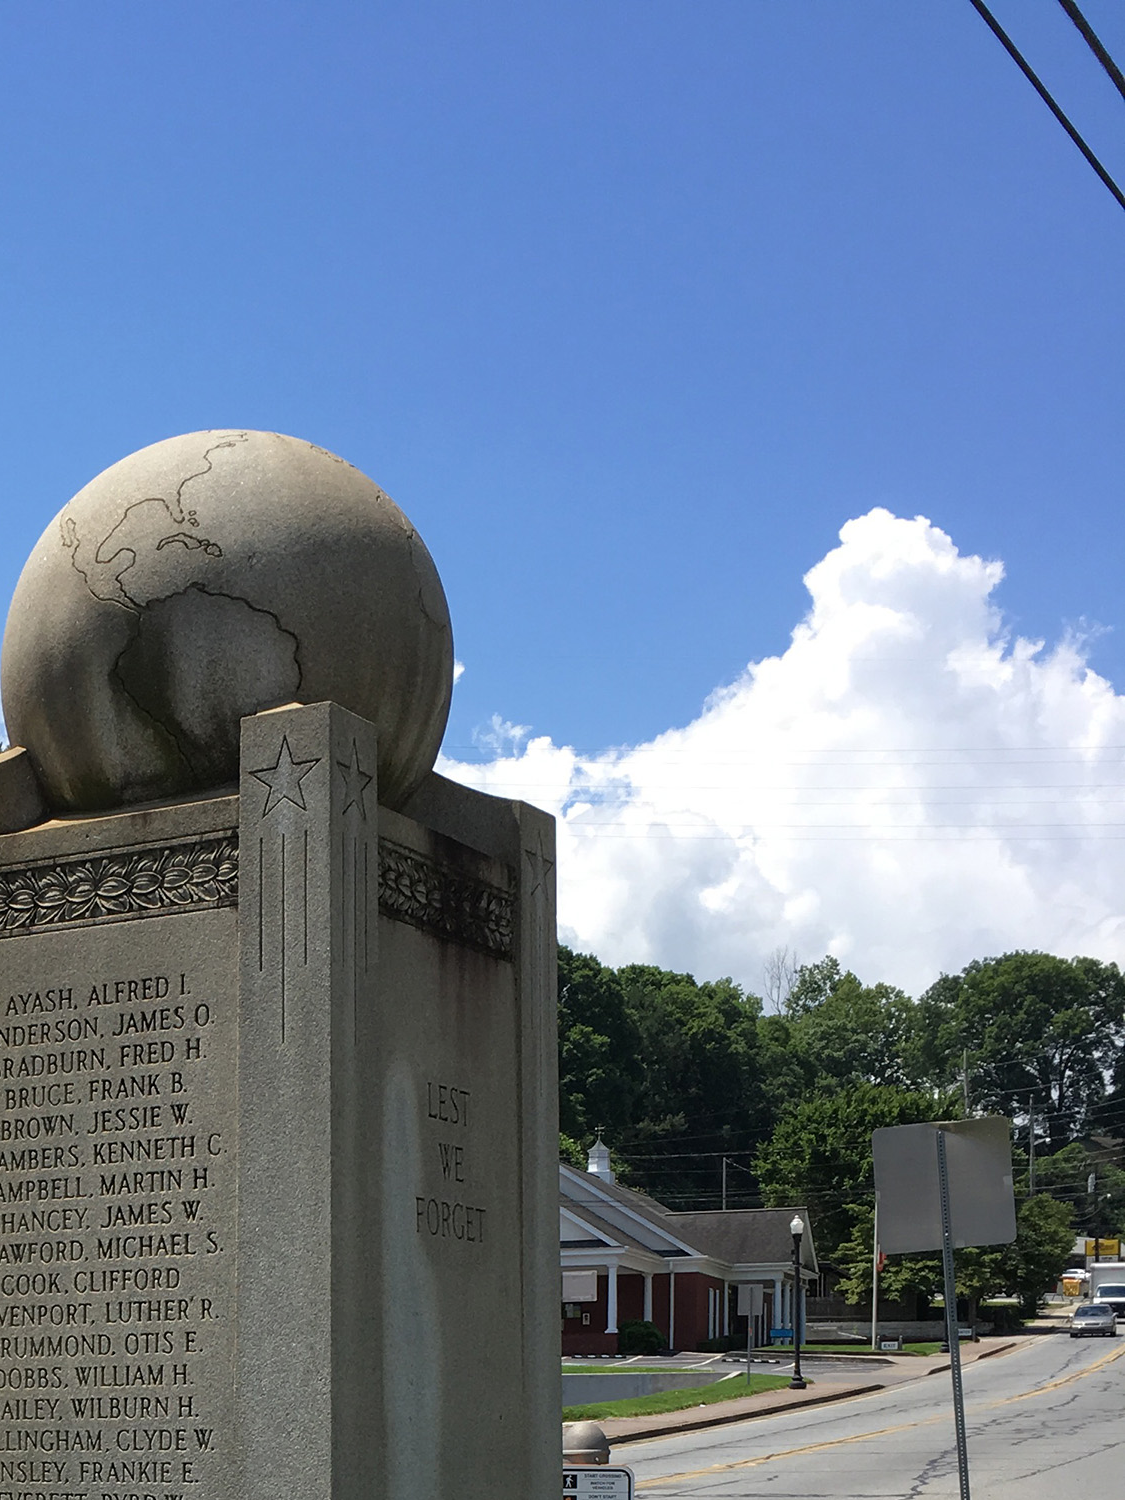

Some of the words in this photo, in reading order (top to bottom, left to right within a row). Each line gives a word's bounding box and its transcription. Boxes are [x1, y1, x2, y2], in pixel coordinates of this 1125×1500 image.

[5, 987, 78, 1016] AYASH,
[88, 976, 170, 1007] ALFRED
[112, 1007, 185, 1036] JAMES
[194, 1003, 214, 1027] O.
[120, 1040, 175, 1068] FRED
[185, 1037, 207, 1060] H.
[5, 1081, 82, 1111] BRUCE,
[88, 1074, 161, 1102] FRANK
[170, 1072, 187, 1094] B.
[427, 1082, 470, 1127] LEST
[1, 1113, 79, 1141] BROWN,
[87, 1107, 163, 1135] JESSIE
[171, 1103, 192, 1126] W.
[93, 1136, 195, 1165] KENNETH
[208, 1133, 227, 1157] C.
[439, 1143, 464, 1183] WE
[100, 1170, 182, 1197] MARTIN
[193, 1167, 215, 1190] H.
[100, 1202, 172, 1229] JAMES
[183, 1199, 204, 1222] W.
[416, 1196, 486, 1243] FORGET
[97, 1233, 196, 1262] MICHAEL
[206, 1231, 223, 1255] S.
[1, 1273, 68, 1296] COOK,
[74, 1268, 180, 1293] CLIFFORD
[106, 1300, 190, 1324] LUTHER
[201, 1298, 219, 1320] R.
[125, 1332, 173, 1355] OTIS
[185, 1331, 203, 1353] E.
[75, 1365, 163, 1387] WILLIAM
[173, 1363, 194, 1385] H.
[71, 1397, 169, 1419] WILBURN
[179, 1396, 199, 1418] H.
[116, 1429, 187, 1452] CLYDE
[195, 1429, 215, 1452] W.
[79, 1462, 172, 1483] FRANKIE
[182, 1462, 199, 1484] E.
